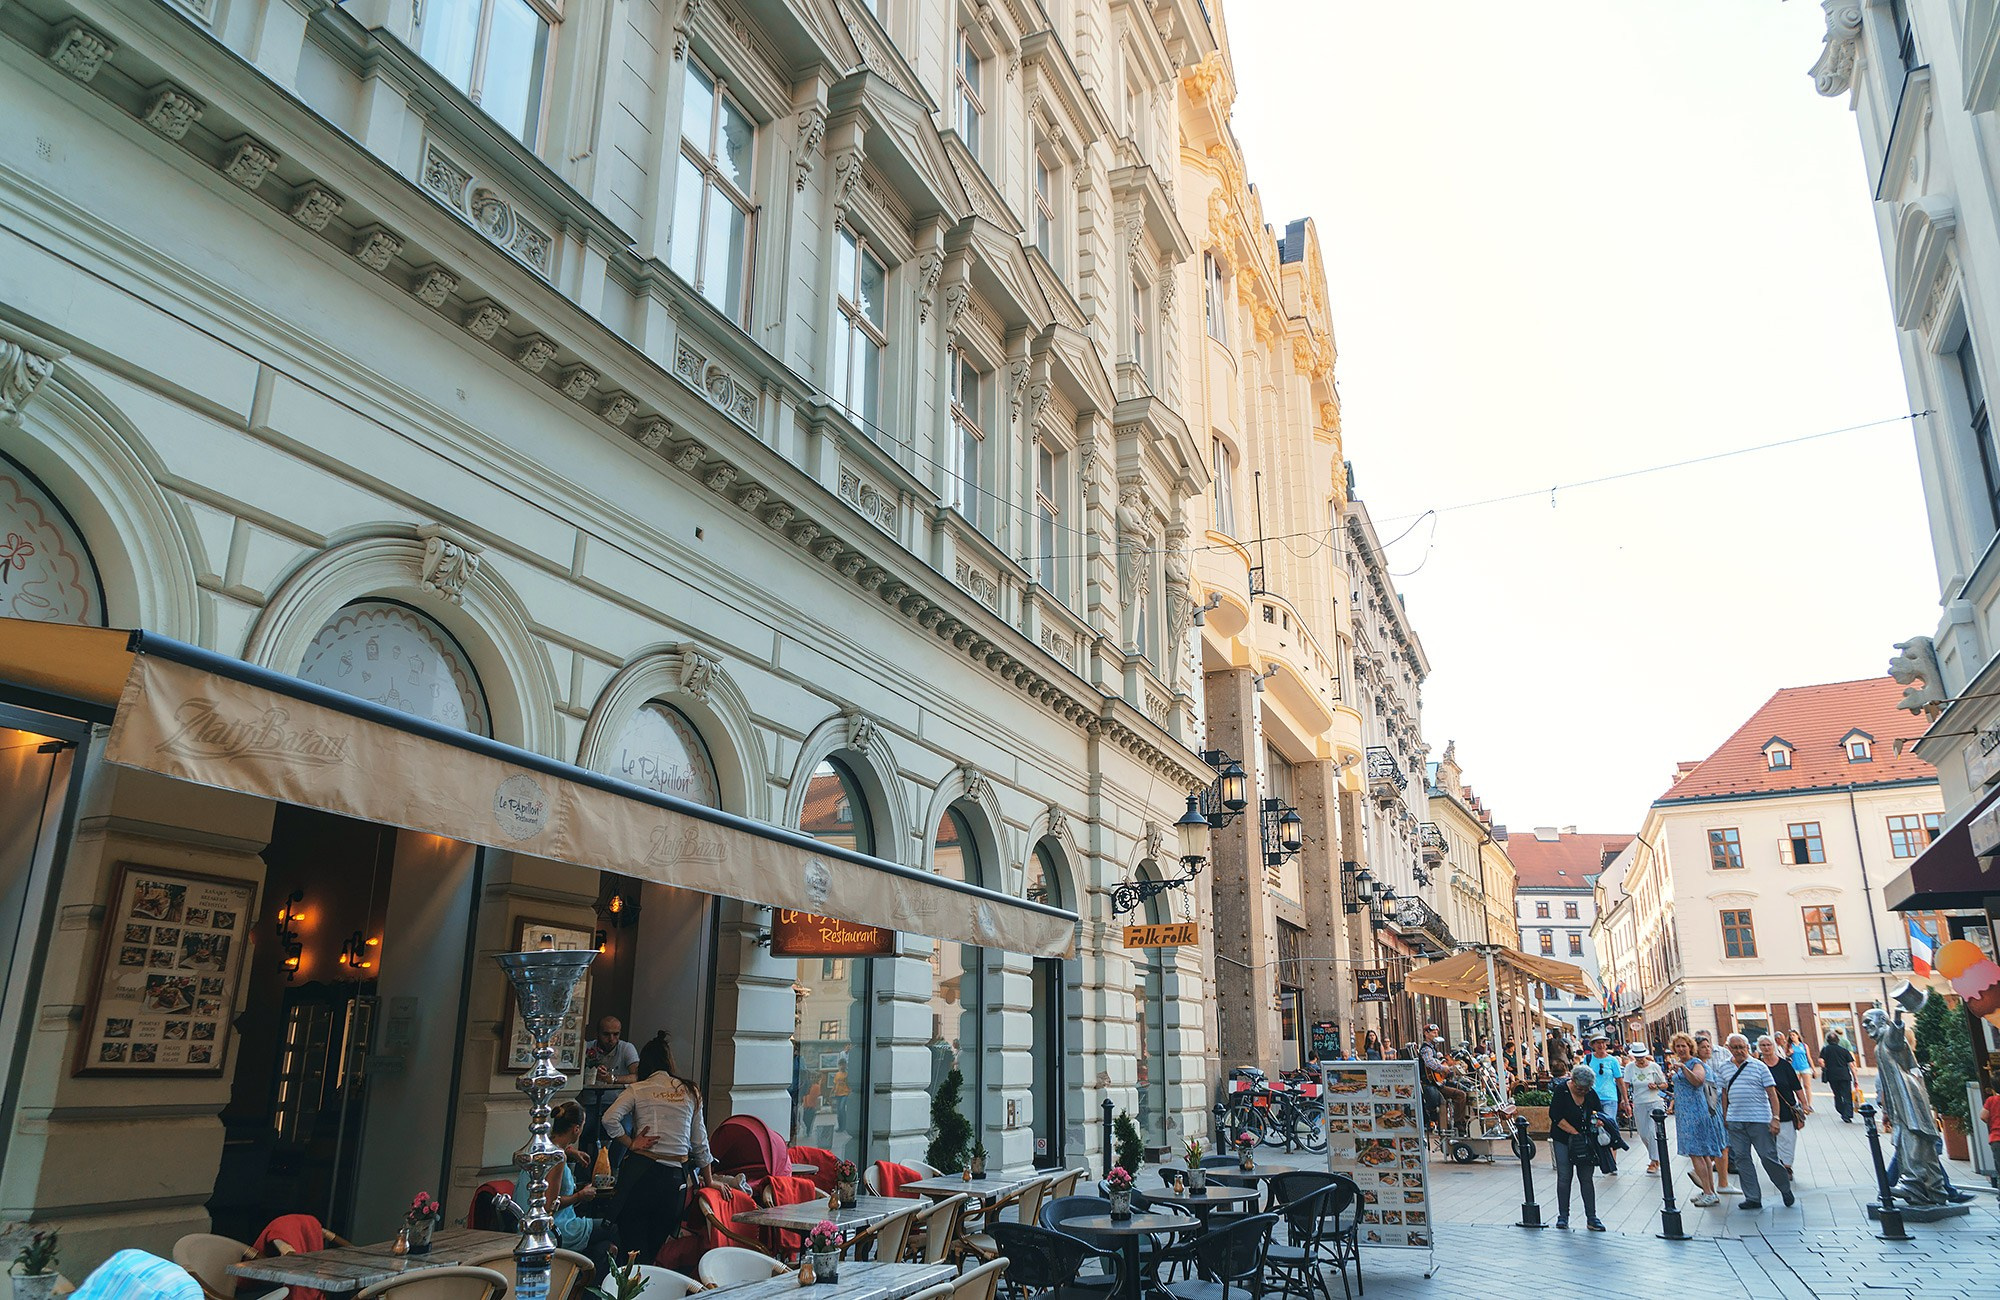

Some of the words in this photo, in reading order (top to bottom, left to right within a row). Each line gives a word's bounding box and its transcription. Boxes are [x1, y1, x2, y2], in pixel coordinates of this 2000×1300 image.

[621, 749, 635, 775] Le
[818, 927, 878, 945] Restaurant
[1357, 969, 1386, 977] ROLAND
